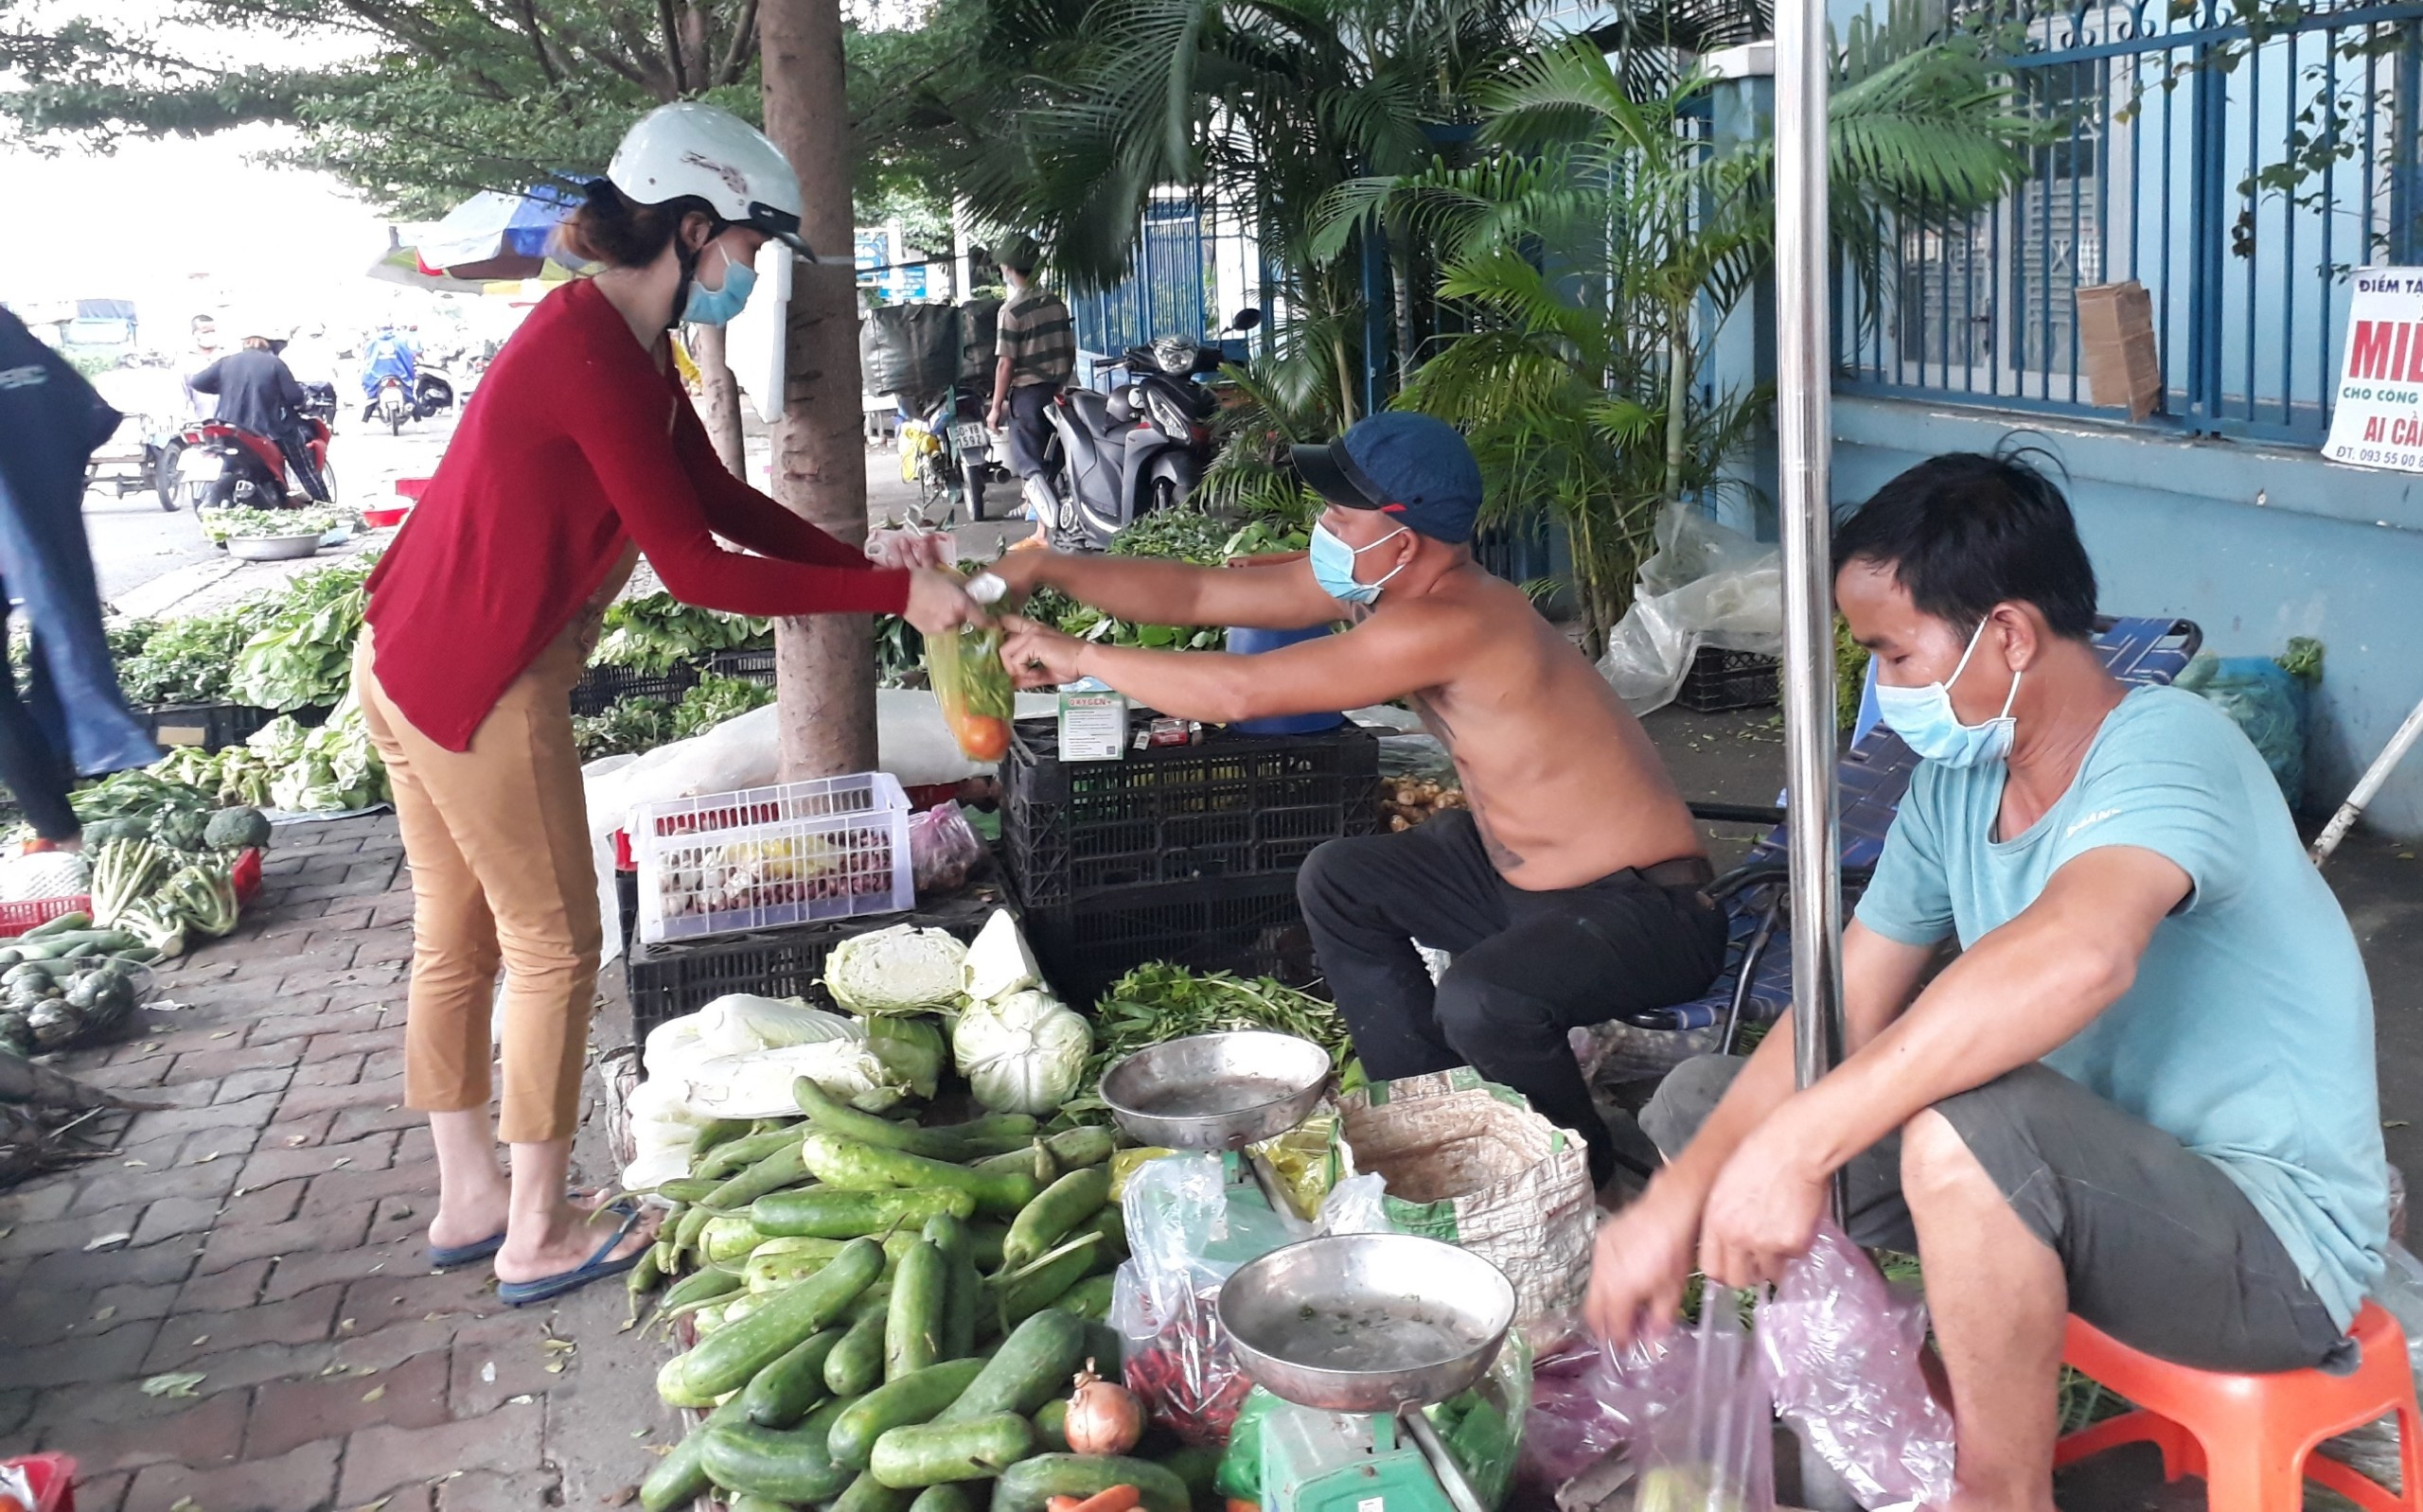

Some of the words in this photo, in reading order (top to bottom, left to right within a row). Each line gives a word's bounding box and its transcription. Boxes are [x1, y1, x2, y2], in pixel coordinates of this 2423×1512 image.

[2343, 387, 2372, 400] CHO
[2363, 416, 2387, 443] AI
[2360, 448, 2381, 463] 093
[2383, 451, 2398, 465] 55
[2400, 454, 2415, 467] 00
